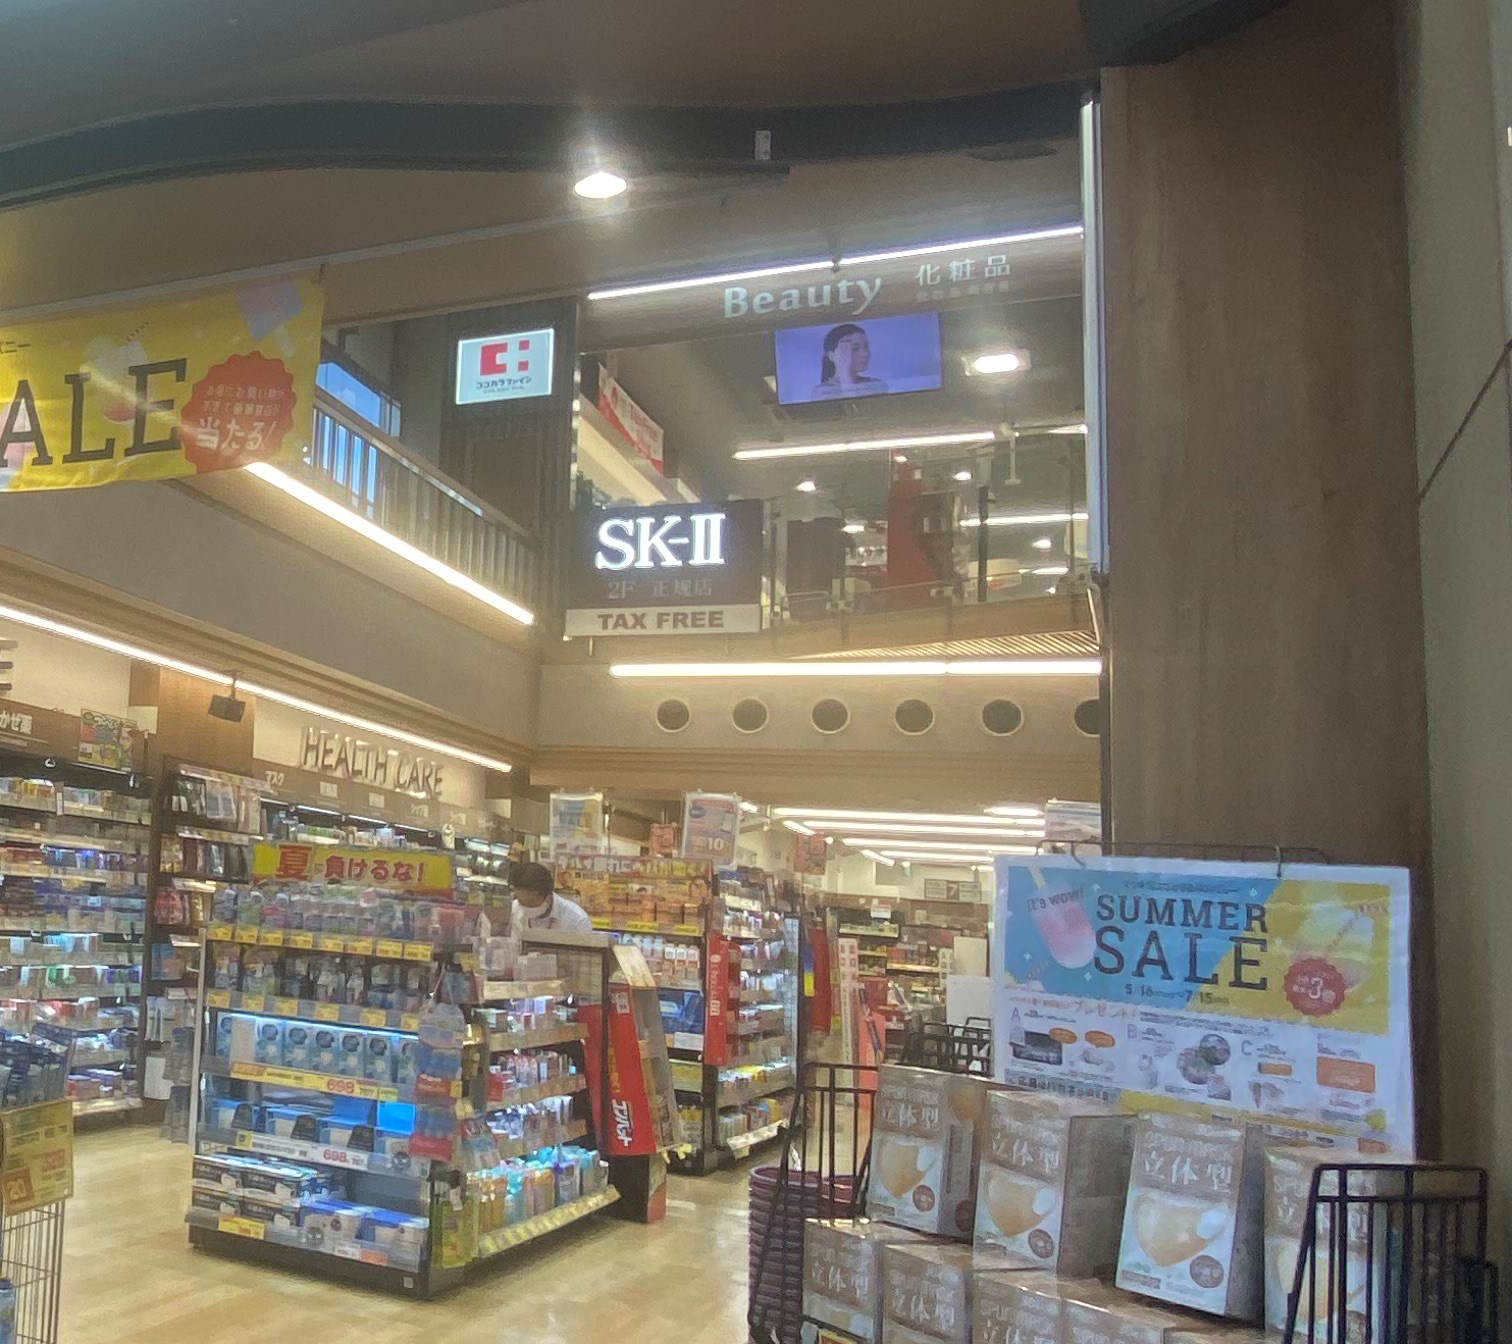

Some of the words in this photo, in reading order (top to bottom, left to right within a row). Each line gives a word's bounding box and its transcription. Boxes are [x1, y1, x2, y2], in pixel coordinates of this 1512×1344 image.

[915, 254, 1011, 287] 化粧品
[724, 277, 882, 318] Beauty
[595, 513, 726, 571] SK-II
[608, 579, 635, 600] 2F
[597, 613, 647, 631] TAX
[656, 611, 725, 629] FREE
[301, 726, 388, 786] HEALTH
[392, 751, 444, 797] CARE
[1096, 893, 1269, 933] SUMMER
[1093, 925, 1268, 991] SALE
[326, 1078, 355, 1095] 698
